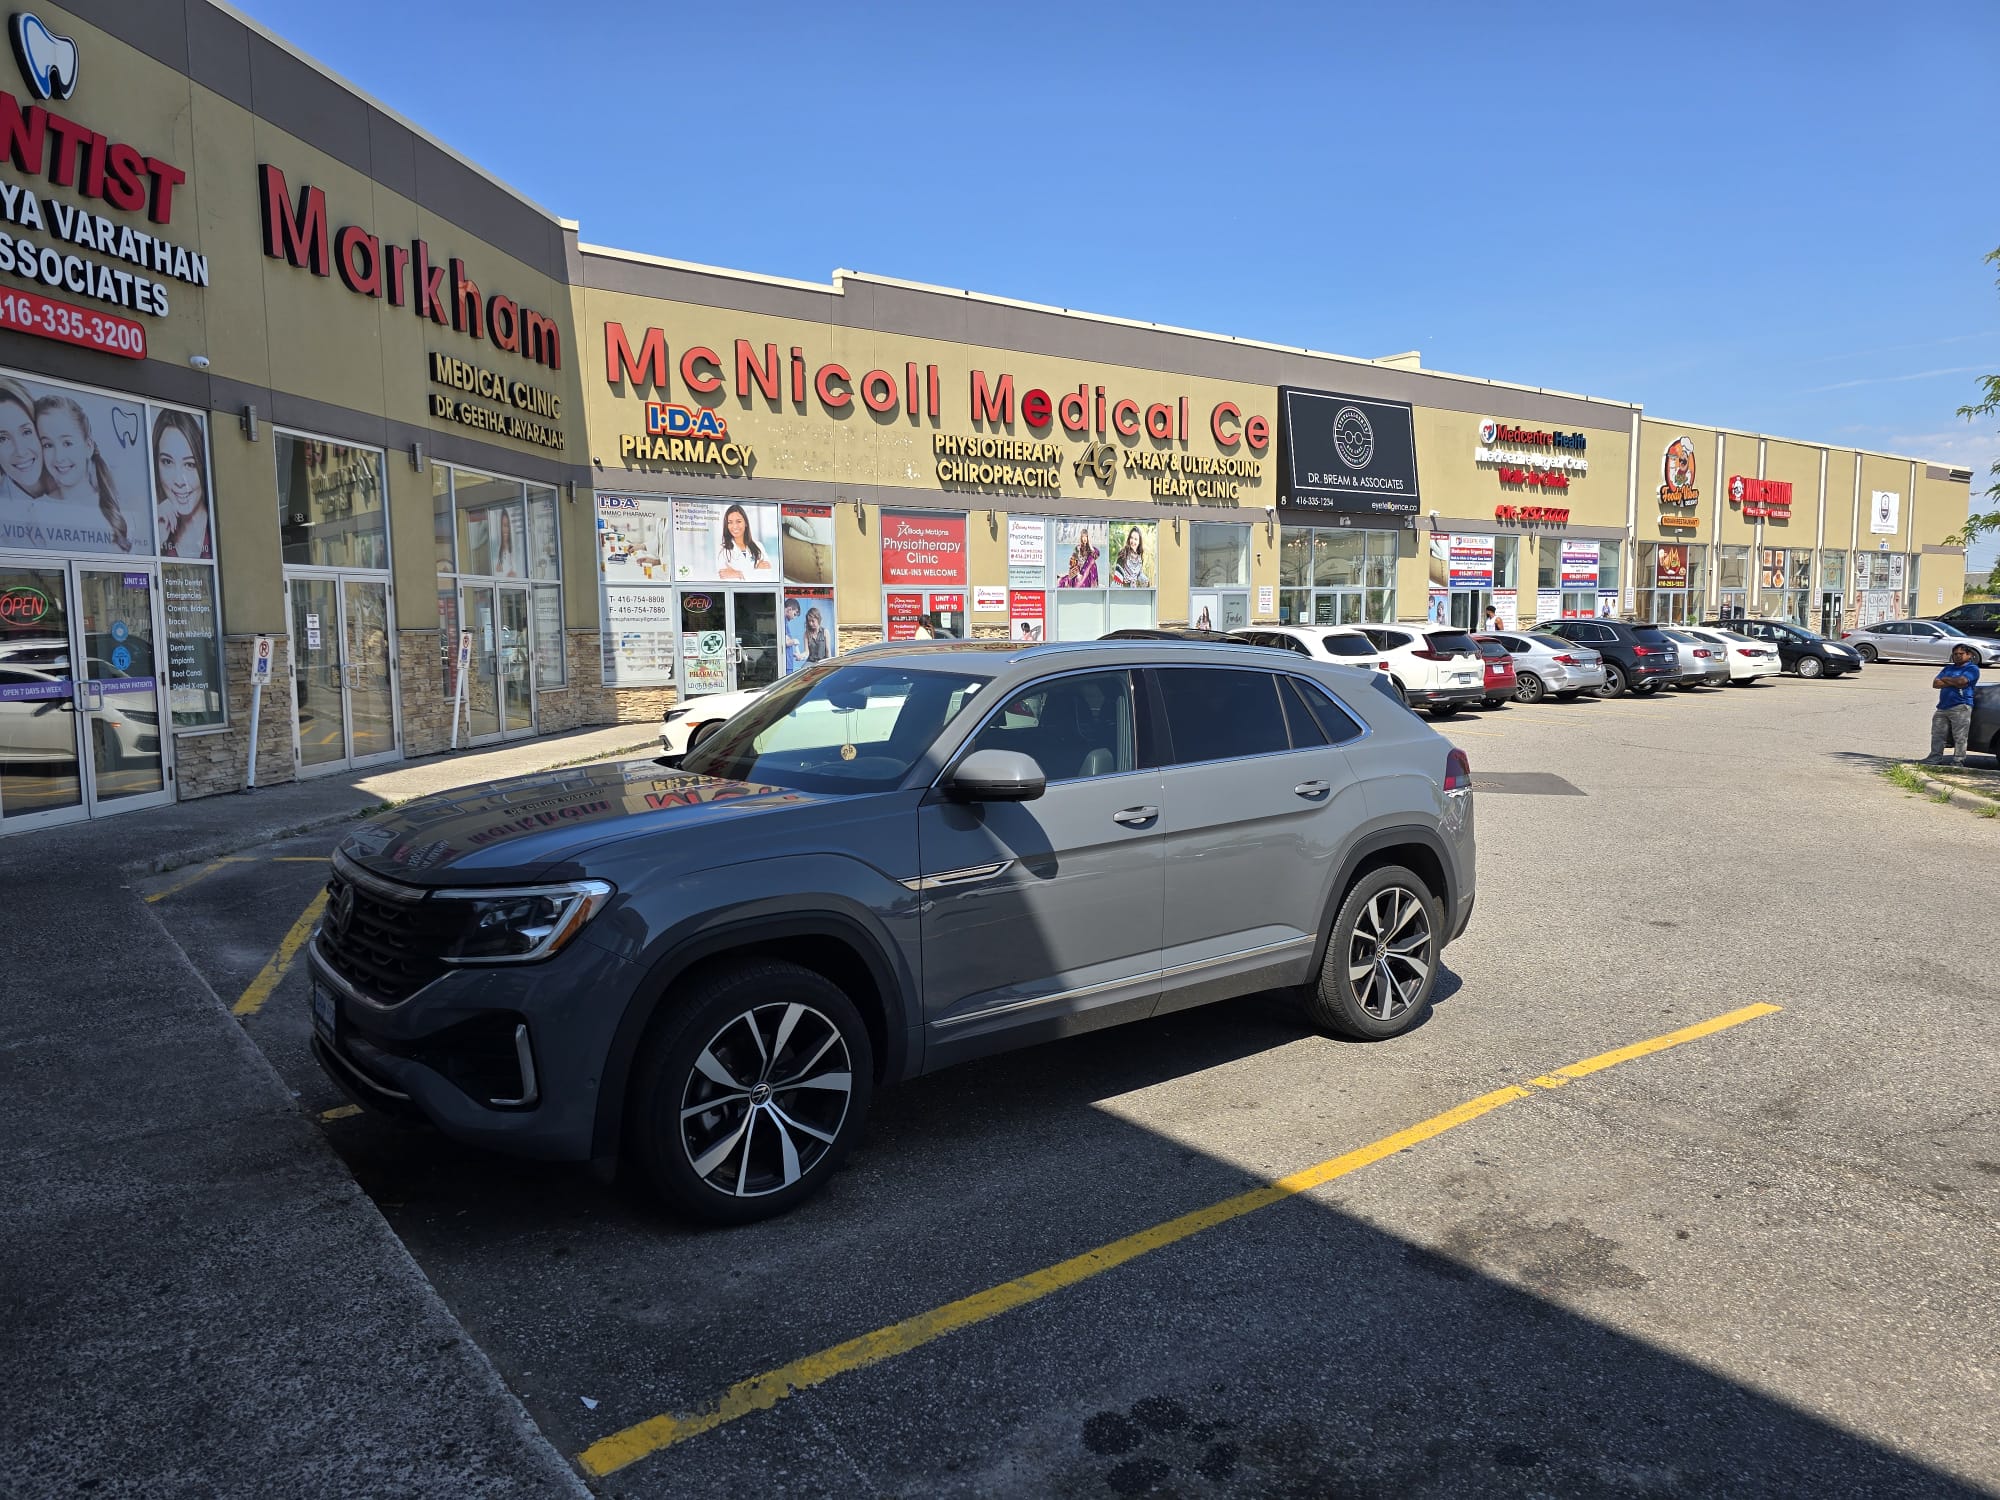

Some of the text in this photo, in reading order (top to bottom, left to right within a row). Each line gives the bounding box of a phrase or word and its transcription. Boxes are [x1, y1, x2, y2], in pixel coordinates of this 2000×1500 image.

[52, 199, 209, 288] VARATHAN
[258, 164, 561, 370] Markham
[435, 351, 562, 420] MEDICAL CLINIC
[604, 321, 1270, 449] McNicoll Medical Ce
[436, 394, 566, 450] DR. GEETHA JAYARAJAH
[1496, 424, 1587, 450] Medcentre Health
[621, 434, 753, 467] PHARMACY
[935, 434, 1063, 464] PHYSIOTHERAPY
[937, 459, 1061, 489] CHIROPRACTIC
[1125, 450, 1262, 478] X-RAY & ULTRASOUND
[1153, 478, 1240, 500] HEART CLINIC
[1307, 472, 1404, 490] DR. BREAM & ASSOCIATES
[1295, 496, 1334, 506] 416-335-1234
[3, 523, 43, 539] VIDYA
[48, 527, 112, 545] VARATHAN
[908, 528, 949, 537] Body Motions
[883, 538, 961, 553] Physiotherapy
[906, 552, 939, 564] Clinic
[123, 577, 139, 586] UNIT
[165, 578, 183, 587] Family
[890, 568, 958, 577] WALK-INS WELCOME
[1, 597, 43, 616] OPEN
[685, 598, 710, 609] OPEN
[2, 688, 19, 697] OPEN
[25, 687, 40, 695] DAYS
